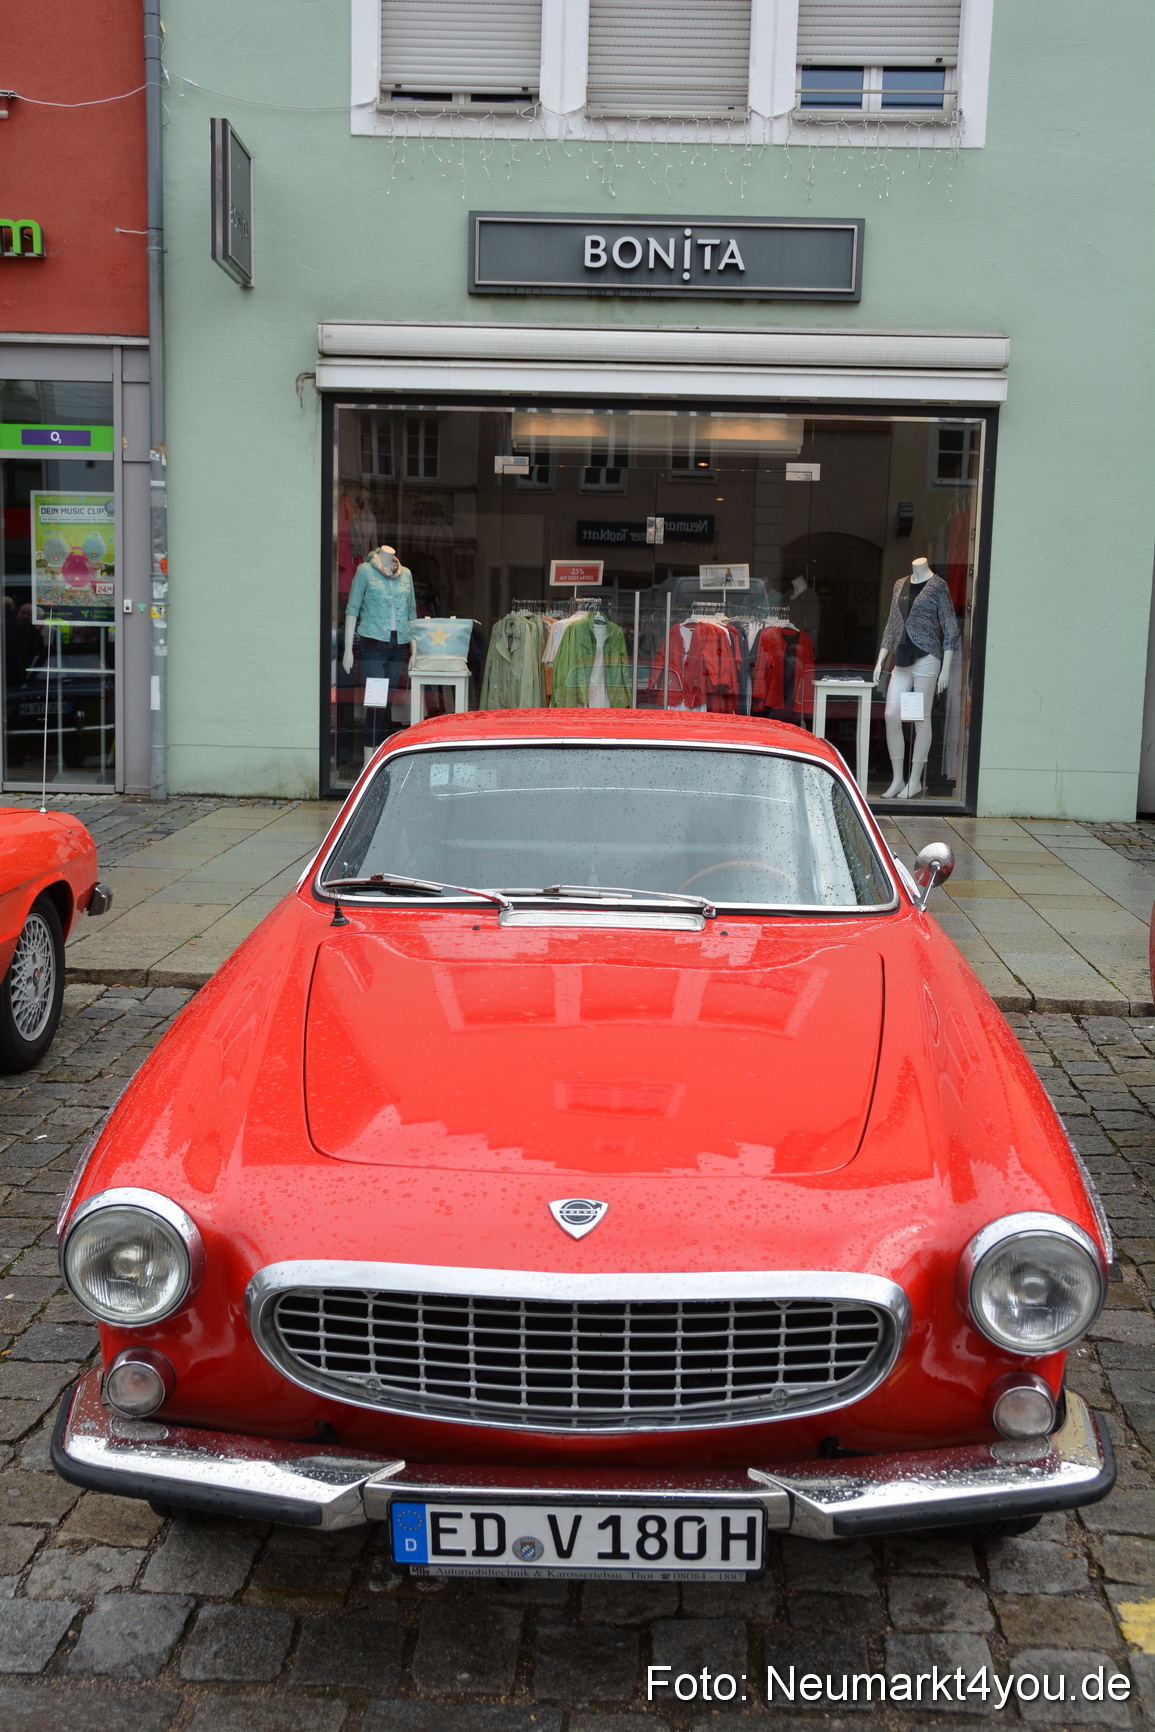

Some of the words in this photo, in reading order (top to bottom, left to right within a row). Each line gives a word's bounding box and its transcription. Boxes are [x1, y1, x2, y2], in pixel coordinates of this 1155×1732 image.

[41, 507, 59, 515] DEIN
[61, 507, 85, 515] MUSIC
[430, 1511, 507, 1557] ED
[405, 1538, 417, 1551] D
[435, 1567, 530, 1577] Automobiltechnik
[547, 1569, 622, 1580] Karosseriebau
[673, 1572, 706, 1580] 08084
[719, 1572, 744, 1581] 1887
